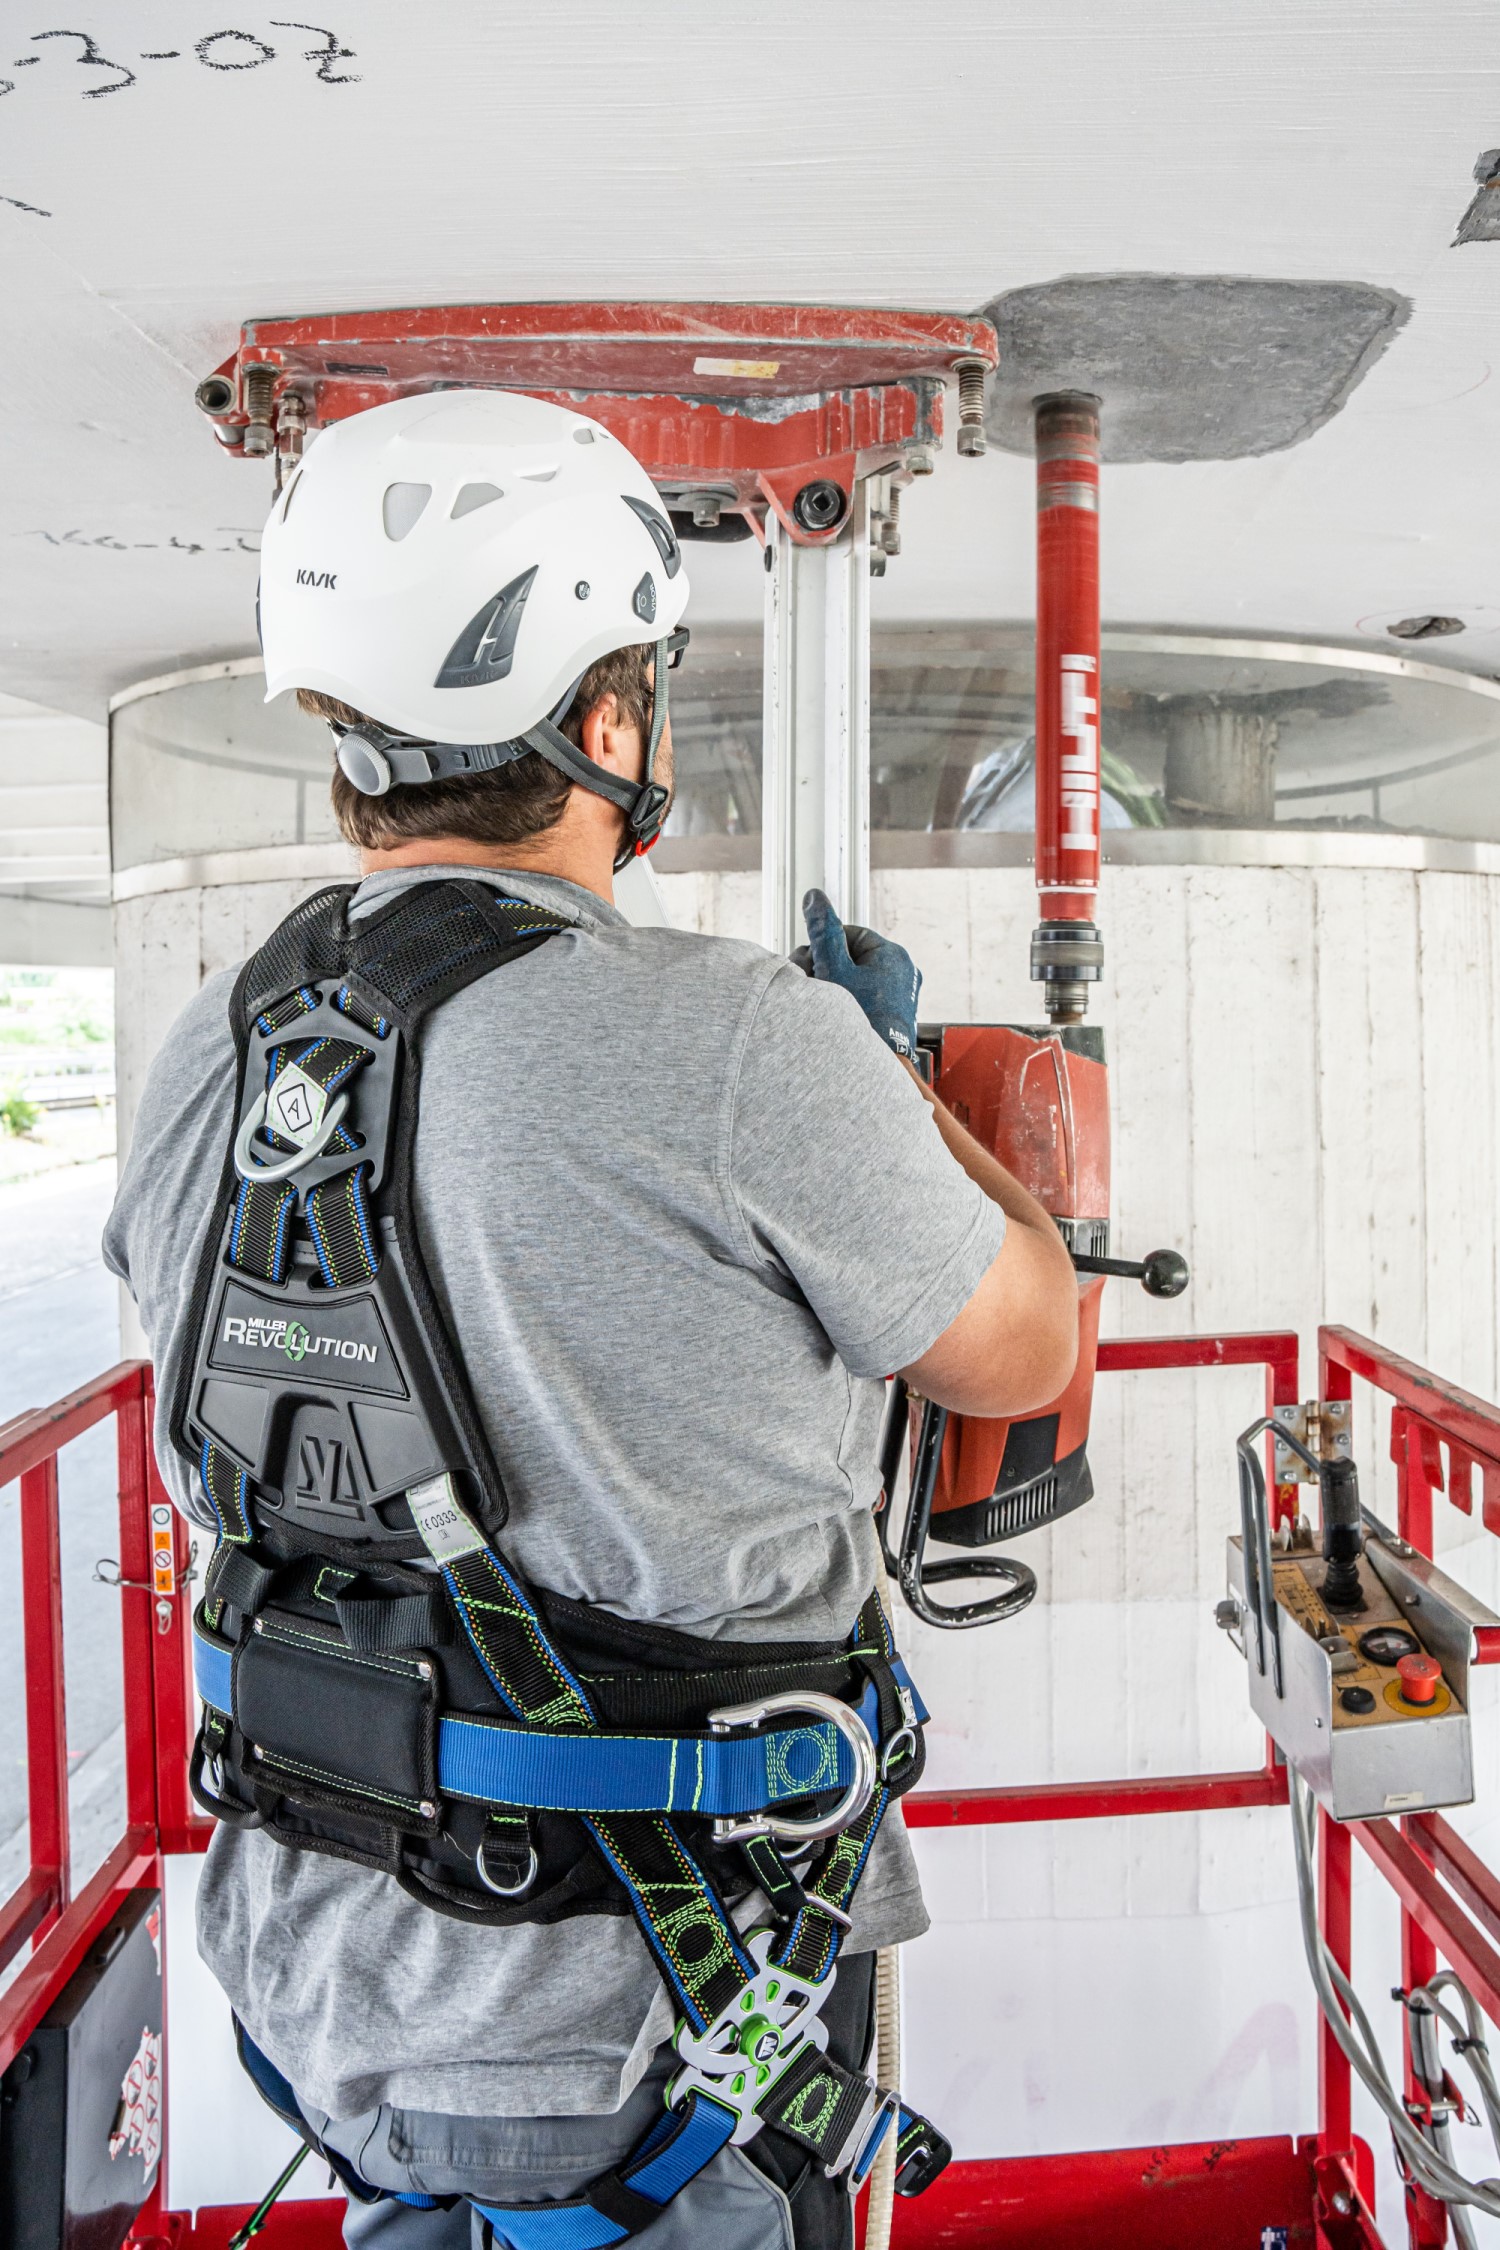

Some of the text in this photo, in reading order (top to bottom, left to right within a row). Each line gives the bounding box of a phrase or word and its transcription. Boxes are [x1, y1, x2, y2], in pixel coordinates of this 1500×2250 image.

[296, 568, 338, 590] KASK
[1061, 653, 1097, 850] HILTI
[287, 1097, 300, 1120] A
[248, 1317, 287, 1331] MILLER
[431, 1510, 458, 1528] 0333
